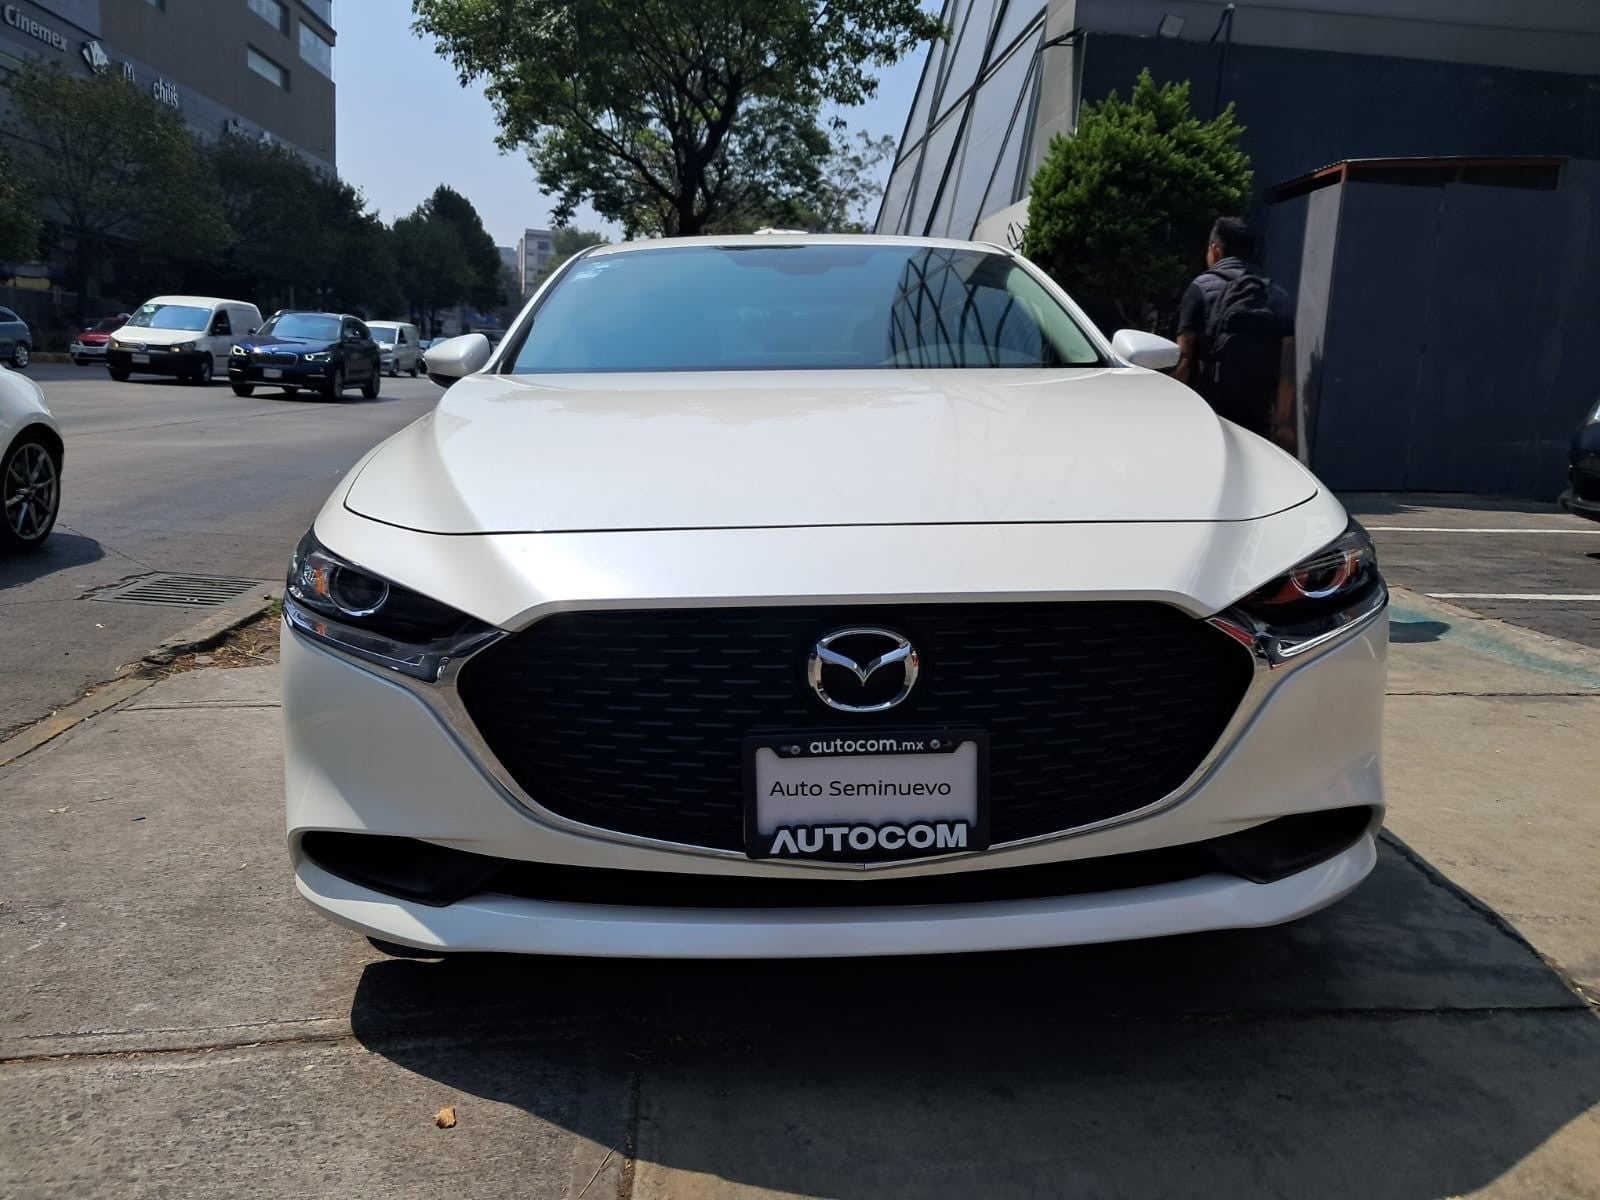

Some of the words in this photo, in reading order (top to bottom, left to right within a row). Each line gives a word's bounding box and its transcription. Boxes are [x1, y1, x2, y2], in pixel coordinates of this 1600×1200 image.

[4, 4, 68, 52] Cinemex
[809, 738, 924, 754] autocom.mx
[769, 780, 823, 797] Auto
[829, 779, 952, 797] Seminuevo
[769, 823, 968, 855] AUTOCOM
